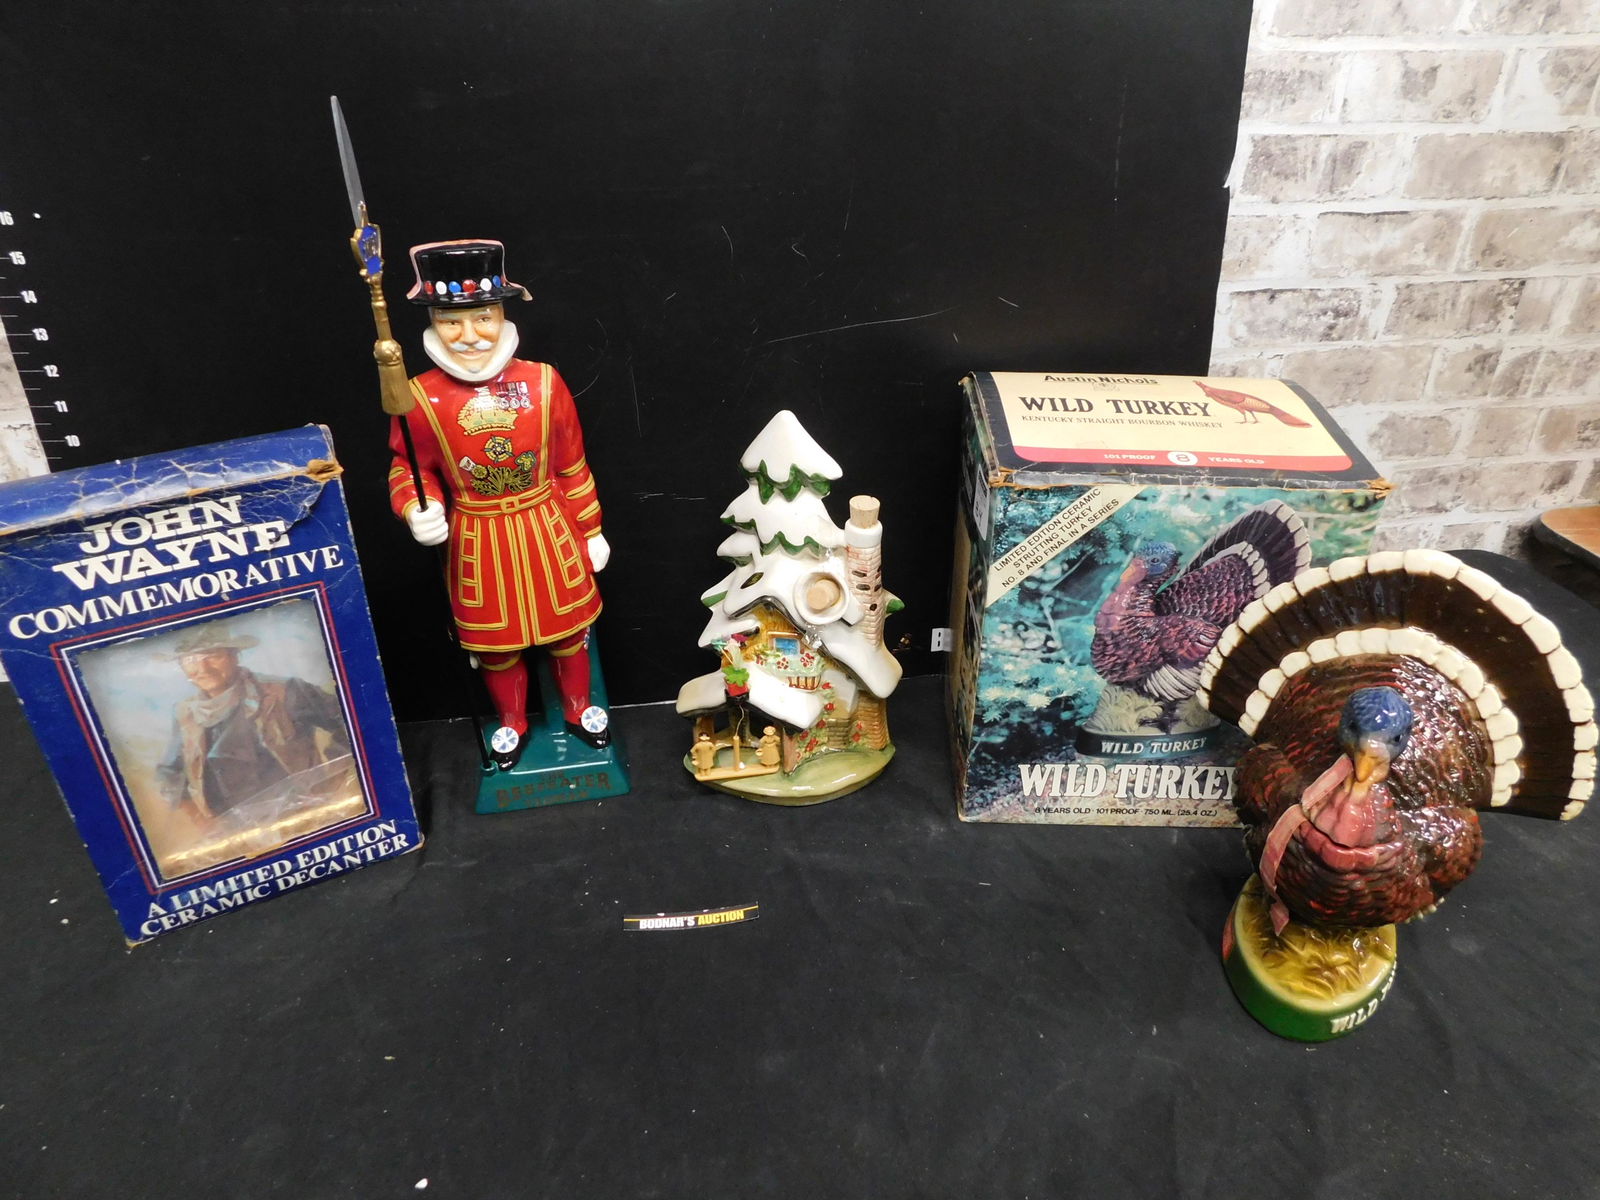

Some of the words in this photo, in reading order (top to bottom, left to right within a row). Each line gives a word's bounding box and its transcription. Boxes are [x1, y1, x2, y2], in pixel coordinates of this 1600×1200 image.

[0, 211, 14, 225] 16
[9, 251, 26, 265] 15
[21, 290, 38, 303] 14
[33, 328, 49, 341] 13
[44, 364, 60, 377] 12
[1044, 375, 1096, 383] Austin
[1099, 377, 1159, 385] Nichols
[54, 401, 68, 413] 11
[1018, 396, 1093, 413] WILD
[1106, 399, 1211, 417] TURKEY
[1021, 415, 1074, 424] KENTUCKY
[1076, 417, 1125, 425] STRAIGHT
[1127, 419, 1176, 427] BOURBON
[1177, 421, 1224, 429] WHISKEY
[64, 434, 80, 447] 10
[1244, 457, 1265, 465] OLD
[79, 495, 243, 554] JOHN
[994, 544, 1028, 573] LIMITED
[1027, 518, 1063, 547] EDITION
[1061, 488, 1102, 521] CERAMIC
[1002, 574, 1019, 588] NO.
[1026, 554, 1044, 571] AND
[1044, 537, 1069, 559] FINAL
[1069, 529, 1080, 538] IN
[1081, 522, 1090, 531] A
[1088, 498, 1120, 524] SERIES
[1013, 532, 1060, 569] STRUTTING
[1060, 505, 1094, 534] TURKEY
[53, 520, 290, 591] WAYNE
[8, 545, 344, 640] COMMEMORATIVE
[1101, 741, 1144, 754] WILD
[1151, 737, 1207, 753] TURKEY
[1018, 764, 1107, 797] WILD
[148, 902, 168, 918] A
[171, 858, 293, 911] LIMITED
[295, 820, 399, 868] EDITION
[140, 883, 272, 936] CERAMIC
[276, 833, 410, 891] DECANTER
[640, 916, 695, 929] BODNAR'S
[697, 910, 745, 925] AUCTION
[1330, 998, 1379, 1033] WILD
